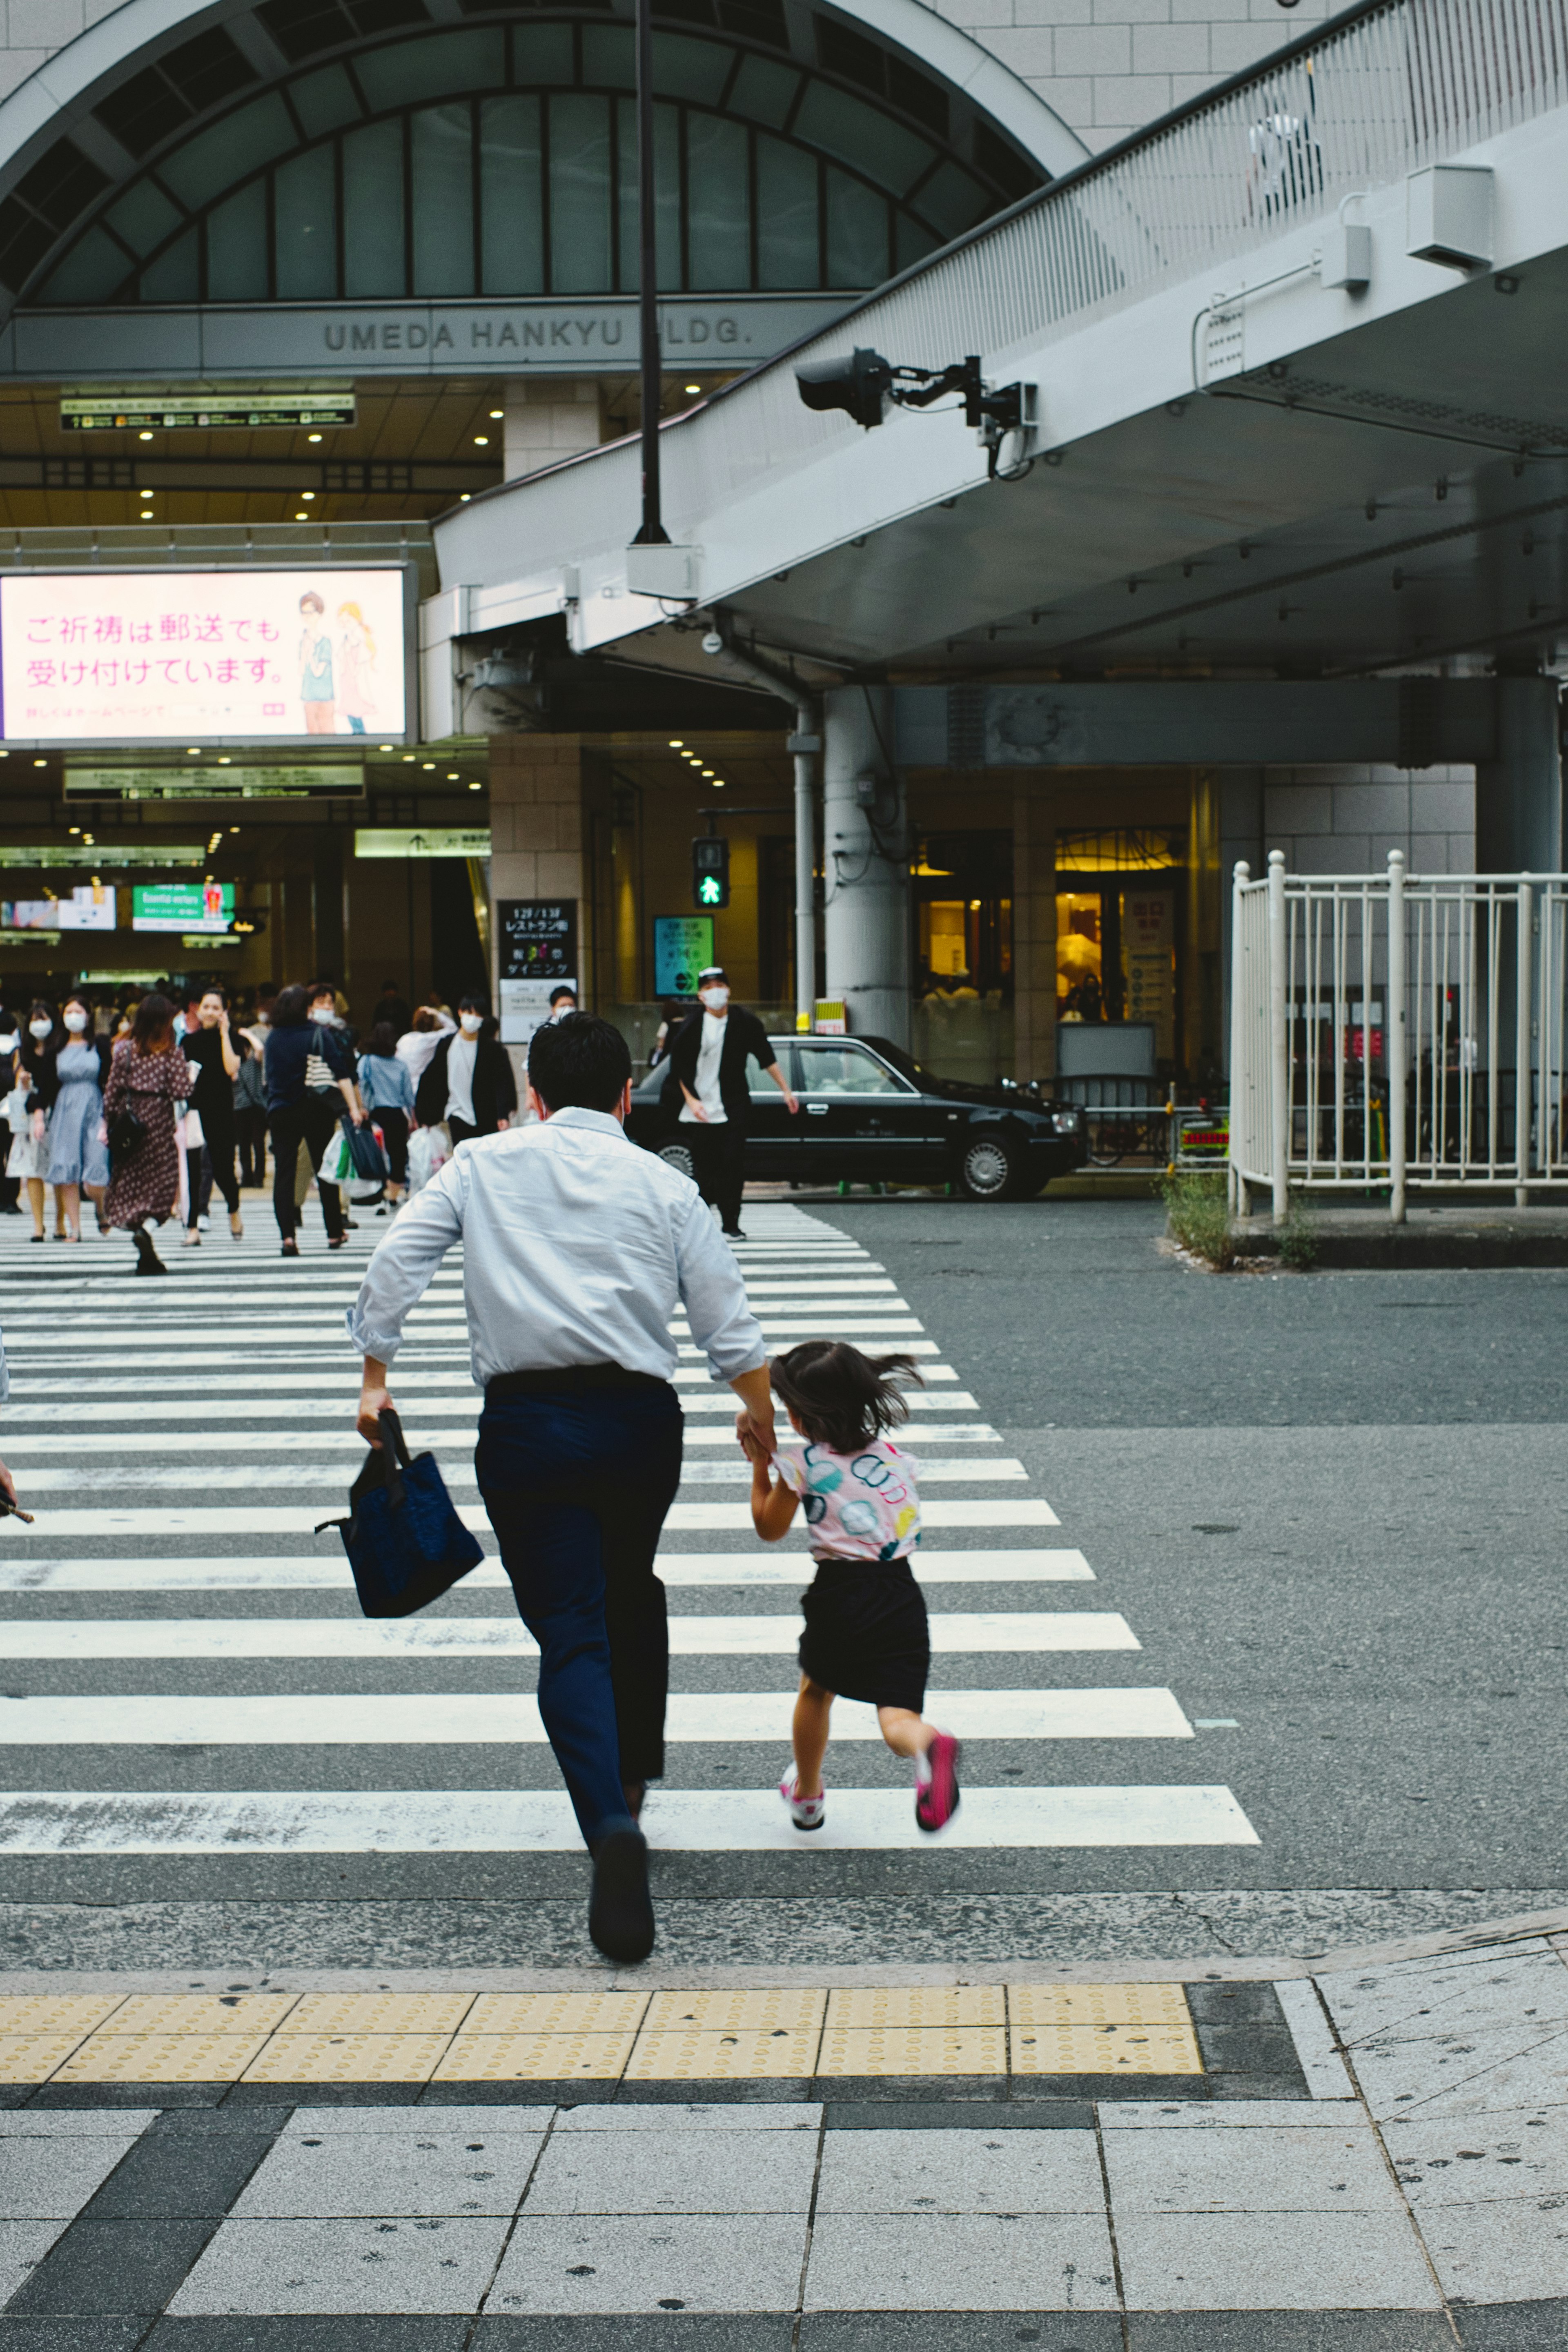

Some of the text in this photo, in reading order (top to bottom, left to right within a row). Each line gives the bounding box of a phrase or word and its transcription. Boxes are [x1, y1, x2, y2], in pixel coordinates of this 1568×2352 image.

[325, 317, 752, 351] UMEDA HANKYU LDG.
[28, 614, 279, 643] ご祈祷は郵送でも
[27, 657, 281, 687] 受け付けています。
